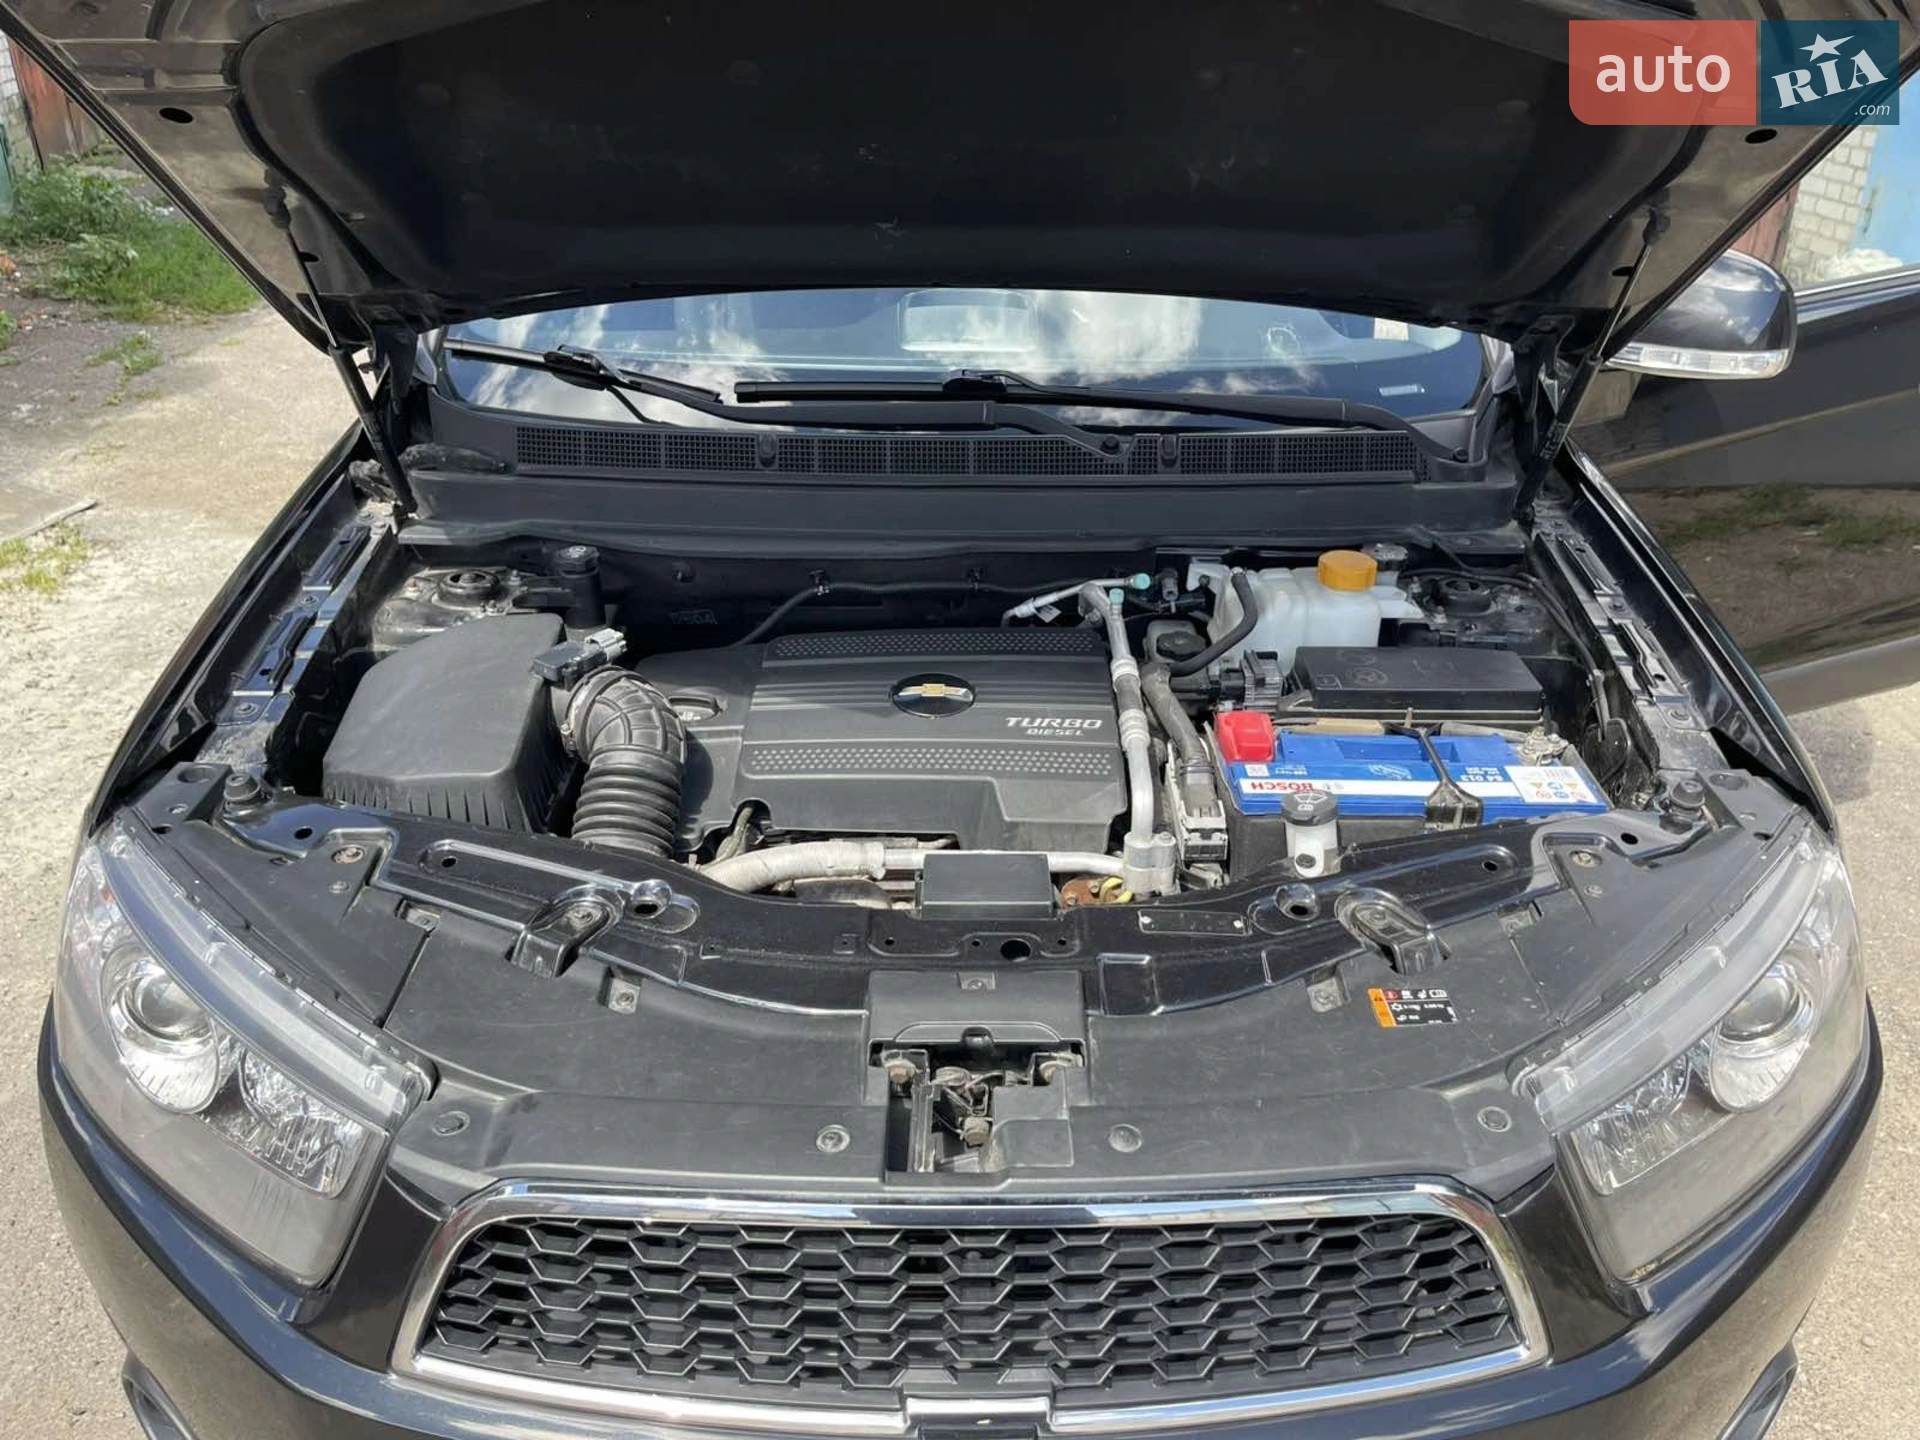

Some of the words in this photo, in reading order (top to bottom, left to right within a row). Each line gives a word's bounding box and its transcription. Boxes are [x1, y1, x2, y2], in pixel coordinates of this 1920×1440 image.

[1005, 717, 1103, 729] TURBO
[1026, 728, 1084, 737] DIESEL
[1251, 781, 1313, 791] BOSCH
